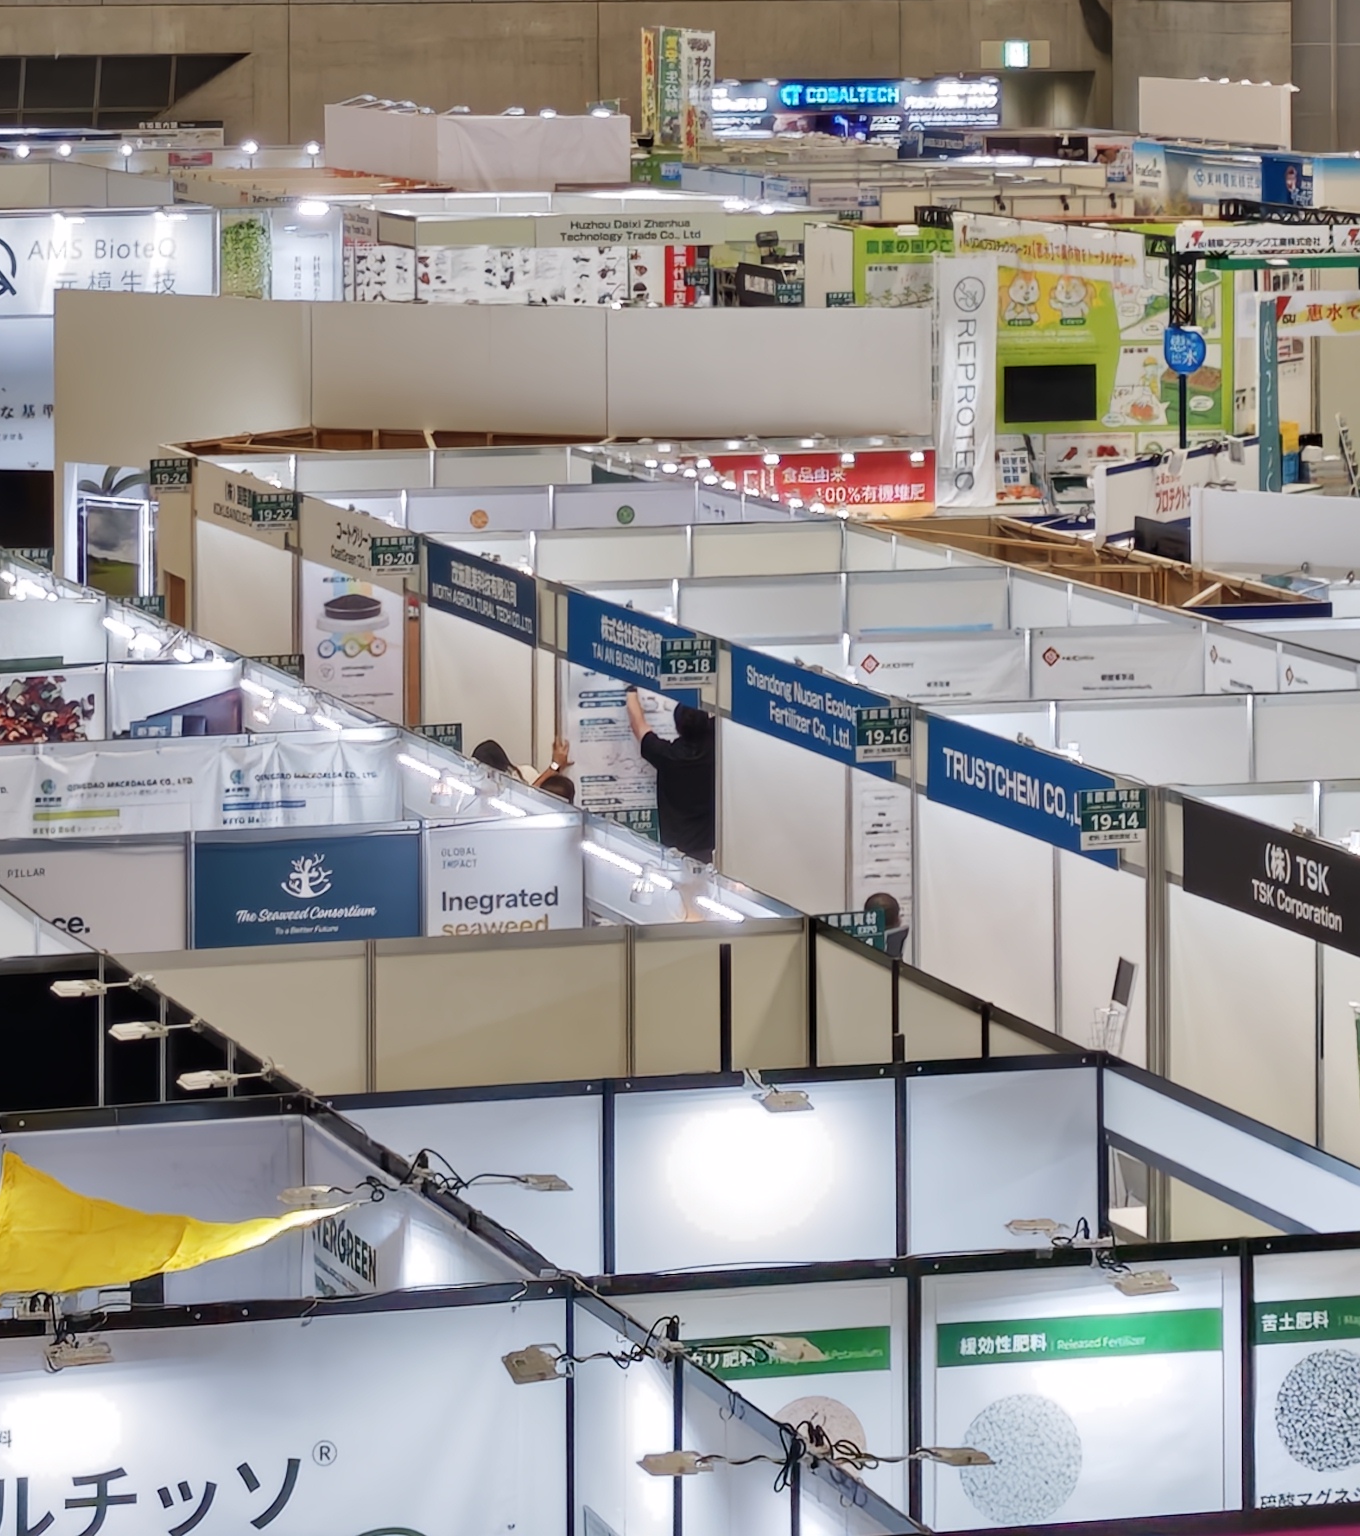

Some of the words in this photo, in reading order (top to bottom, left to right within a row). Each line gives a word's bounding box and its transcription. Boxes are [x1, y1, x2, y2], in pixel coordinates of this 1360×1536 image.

[806, 86, 900, 104] COBALTECH
[28, 239, 83, 260] AMS
[95, 237, 178, 260] BioteQ
[155, 472, 188, 484] 19-24
[257, 508, 294, 521] 19-22
[377, 551, 415, 565] 19-20
[669, 658, 711, 674] 19-18
[746, 664, 792, 703] Shandong
[768, 701, 811, 735] Fertilizer
[832, 725, 852, 751] Ltd.
[865, 728, 910, 745] 19-16
[942, 746, 1040, 810] TRUSTCHEM
[1091, 813, 1140, 830] 19-14
[441, 846, 477, 858] GLOBAL
[1263, 844, 1292, 882] (株)
[1294, 861, 1331, 896] TSK
[441, 886, 560, 916] Inegrated
[1252, 878, 1274, 907] TSK
[1277, 886, 1342, 934] Corporation
[236, 909, 255, 924] The
[257, 906, 308, 923] Seaweed
[308, 904, 378, 920] Consortium
[441, 914, 549, 936] seaweed
[1260, 1312, 1330, 1333] 苦土肥料
[959, 1332, 1049, 1357] 緩効性肥料
[1058, 1335, 1101, 1351] Released
[1103, 1333, 1146, 1349] Fertilizer
